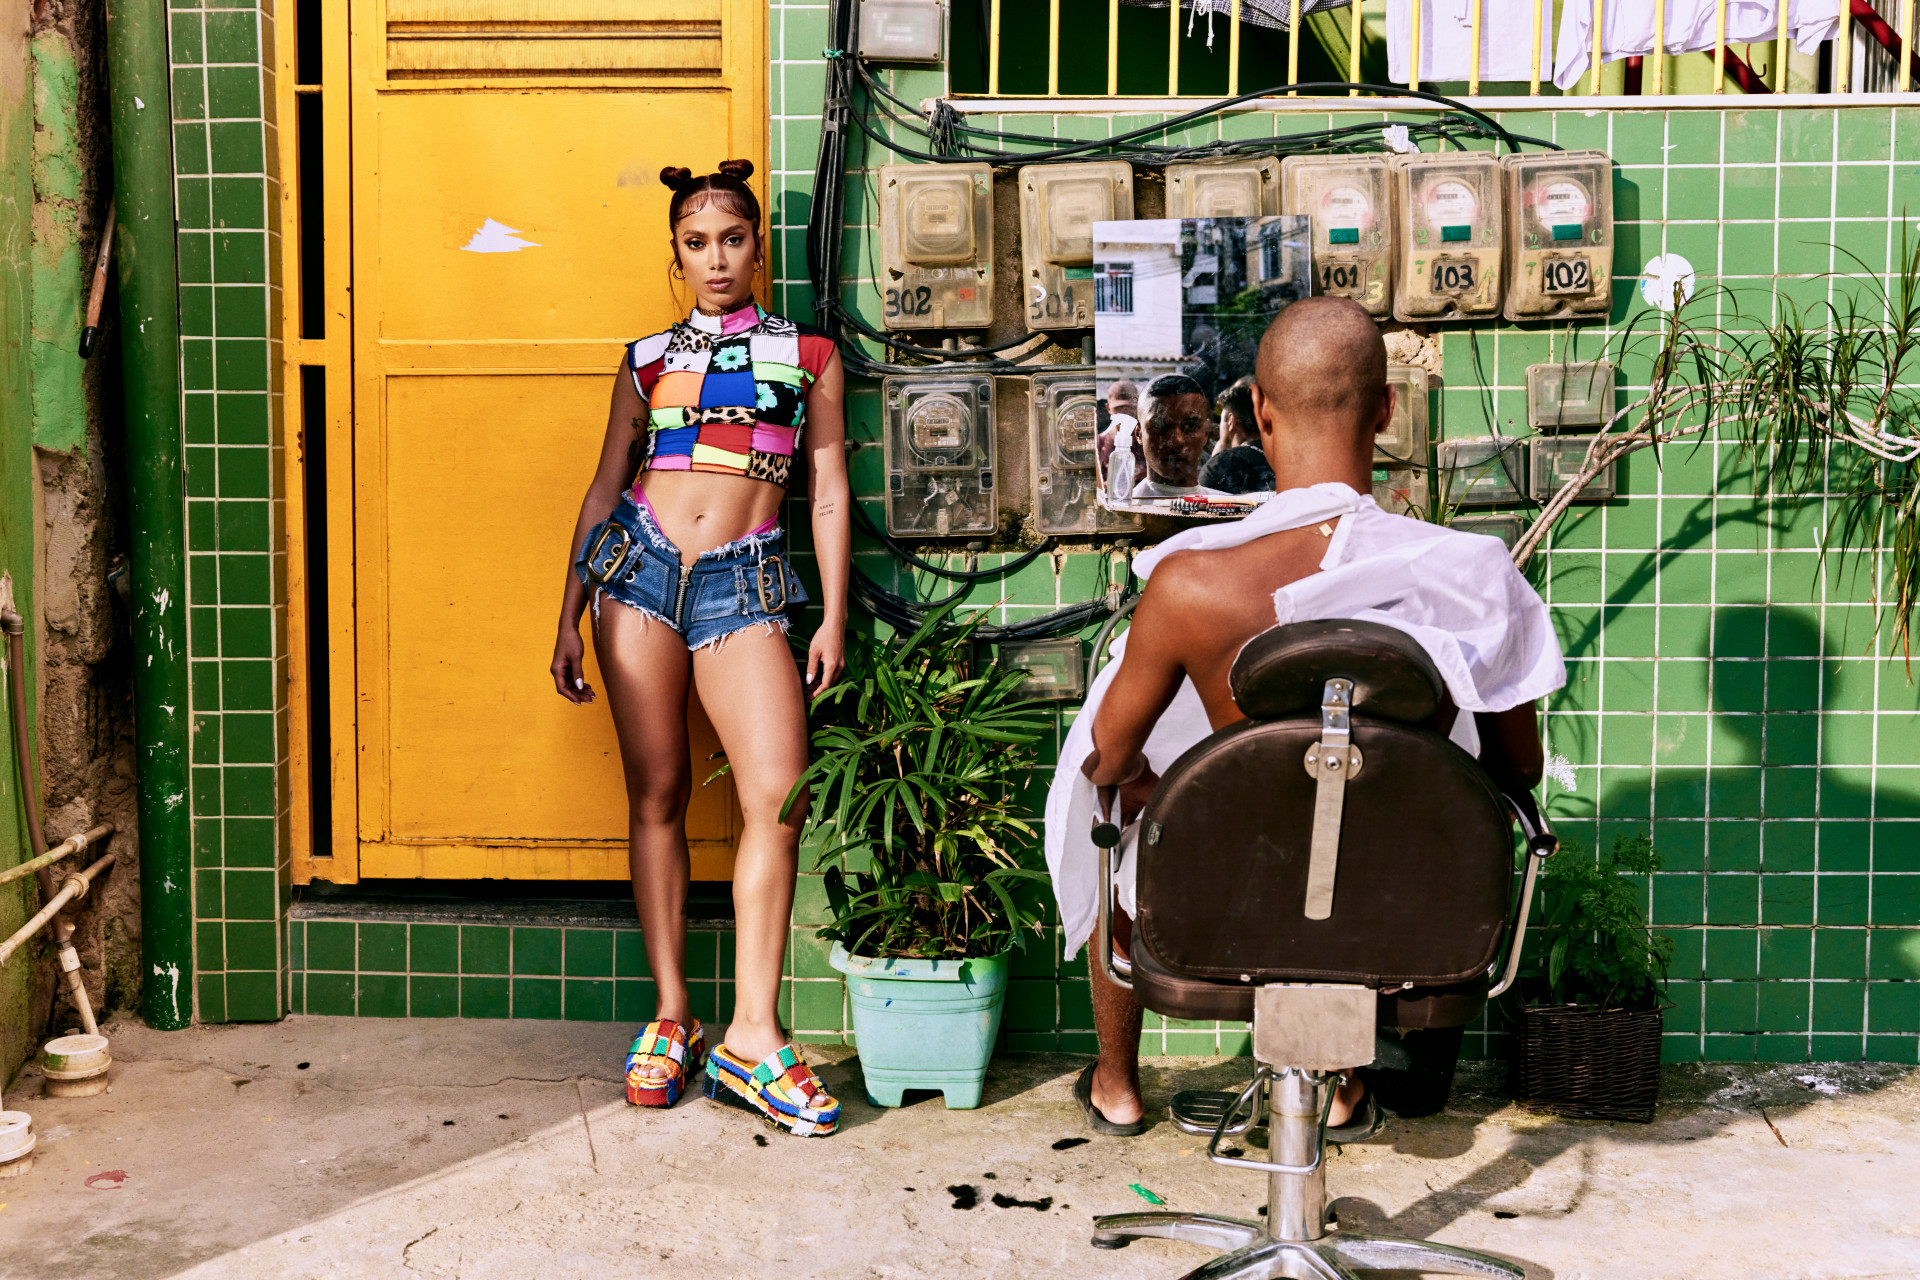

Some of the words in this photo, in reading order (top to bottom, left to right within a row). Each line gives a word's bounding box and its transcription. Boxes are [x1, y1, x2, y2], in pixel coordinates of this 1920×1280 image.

[1322, 264, 1358, 291] 101
[1435, 265, 1474, 291] 103
[1545, 261, 1589, 291] 102
[885, 285, 932, 317] 302
